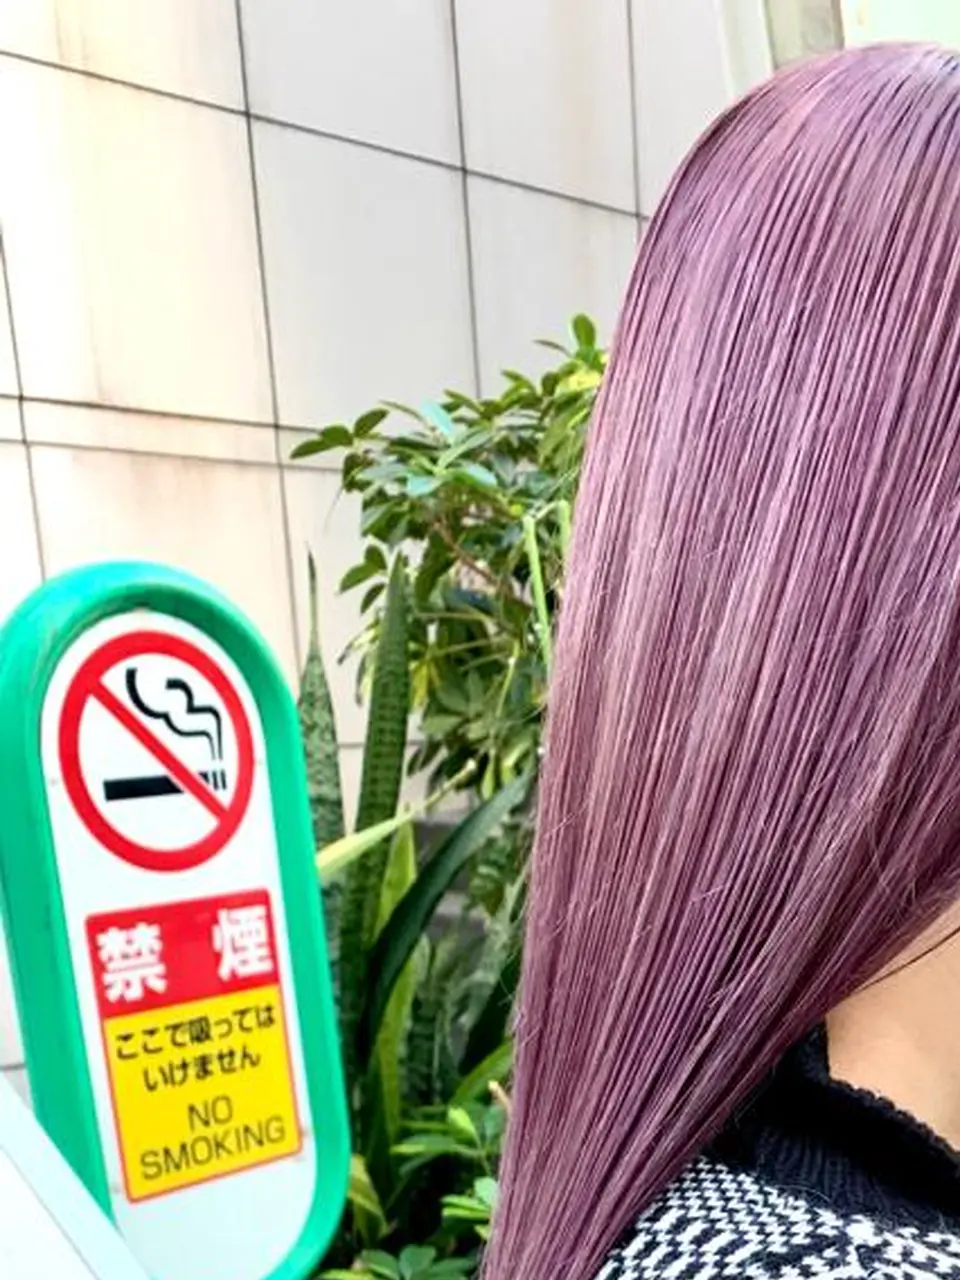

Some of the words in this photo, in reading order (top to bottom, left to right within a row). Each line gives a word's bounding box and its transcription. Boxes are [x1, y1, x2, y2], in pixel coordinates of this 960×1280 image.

[97, 905, 272, 1002] 禁煙
[116, 1005, 275, 1060] ここで吸っては
[143, 1046, 260, 1092] いけません
[187, 1095, 233, 1131] NO
[140, 1115, 286, 1180] SMOKING
